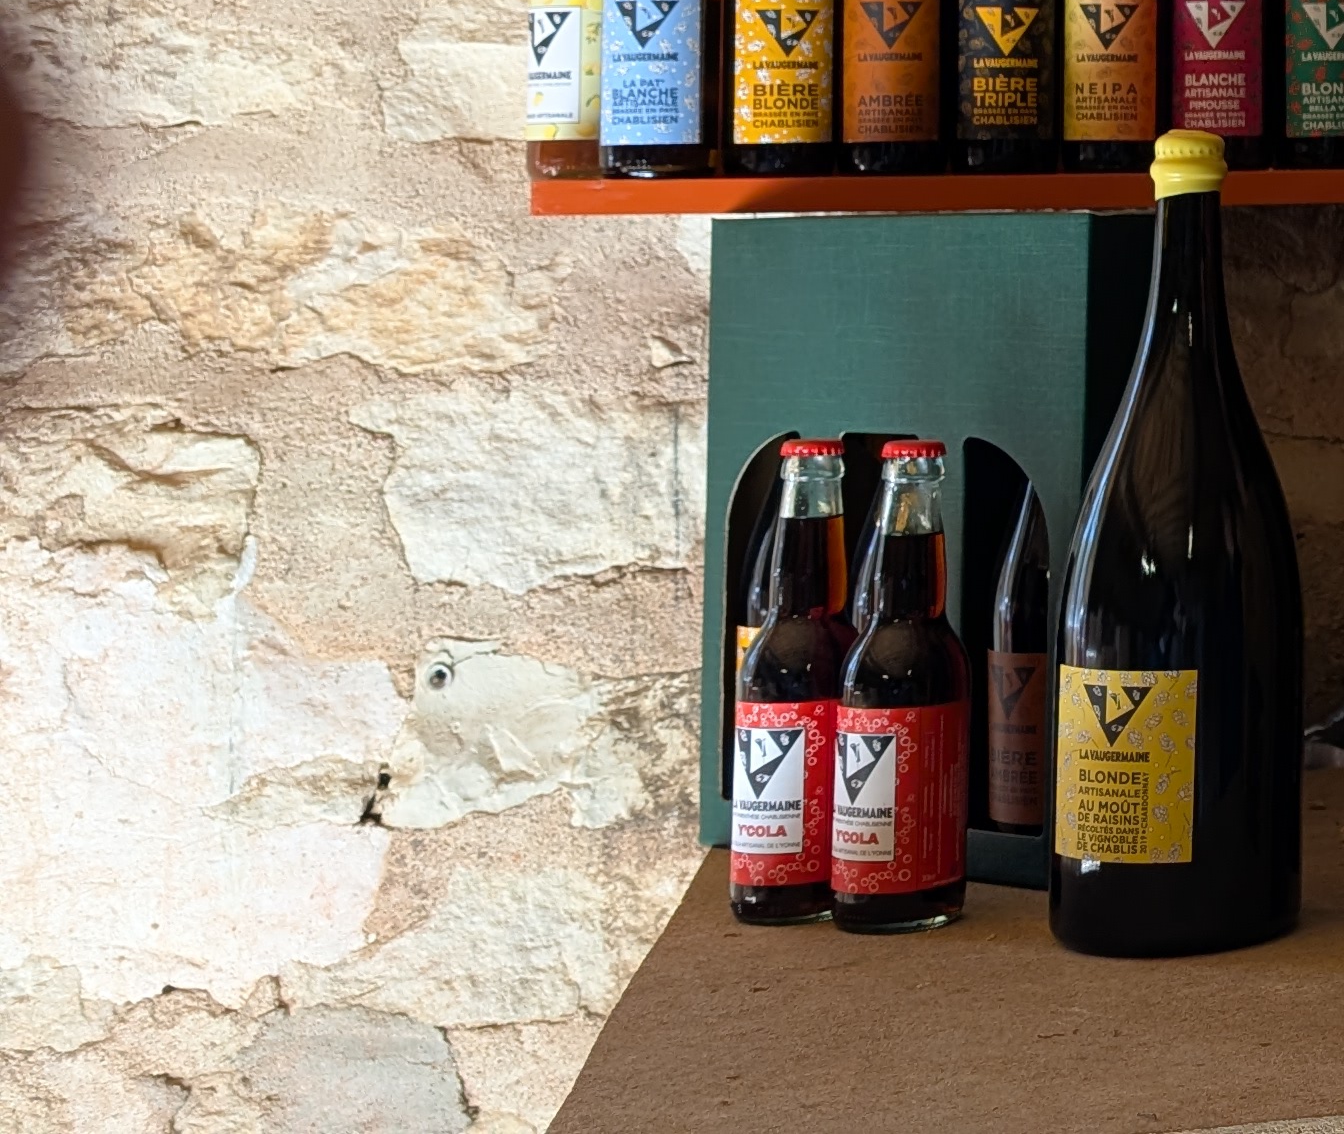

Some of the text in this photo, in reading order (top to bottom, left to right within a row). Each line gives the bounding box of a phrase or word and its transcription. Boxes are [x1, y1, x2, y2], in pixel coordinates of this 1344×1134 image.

[623, 79, 636, 88] LA
[973, 73, 1037, 91] BIÈRE
[1185, 73, 1245, 86] BLANCHE
[612, 88, 678, 99] BLANCHE
[753, 81, 819, 96] BIÈRE
[1185, 88, 1245, 98] ARTISANALE
[753, 98, 818, 110] BLONDE
[857, 92, 923, 107] AMBRÉE
[973, 92, 1037, 107] TRIPLE
[1189, 99, 1240, 110] PIMOUSSE
[1079, 749, 1150, 763] LA VAUGERMAINE
[1079, 769, 1141, 785] BLONDE
[1078, 786, 1140, 798] ARTISANALE
[739, 799, 802, 811] VAUGERMAINE
[1078, 799, 1140, 815] AU MOÛT
[1141, 772, 1149, 830] CHARDONNAY
[838, 806, 893, 818] VAUGERMAINE
[1078, 812, 1140, 826] DE RAISINS
[1078, 823, 1139, 835] RÉCOLTÉS DANS
[1078, 832, 1138, 845] LE VIGNOBLE
[1077, 841, 1137, 855] DE CHABLIS
